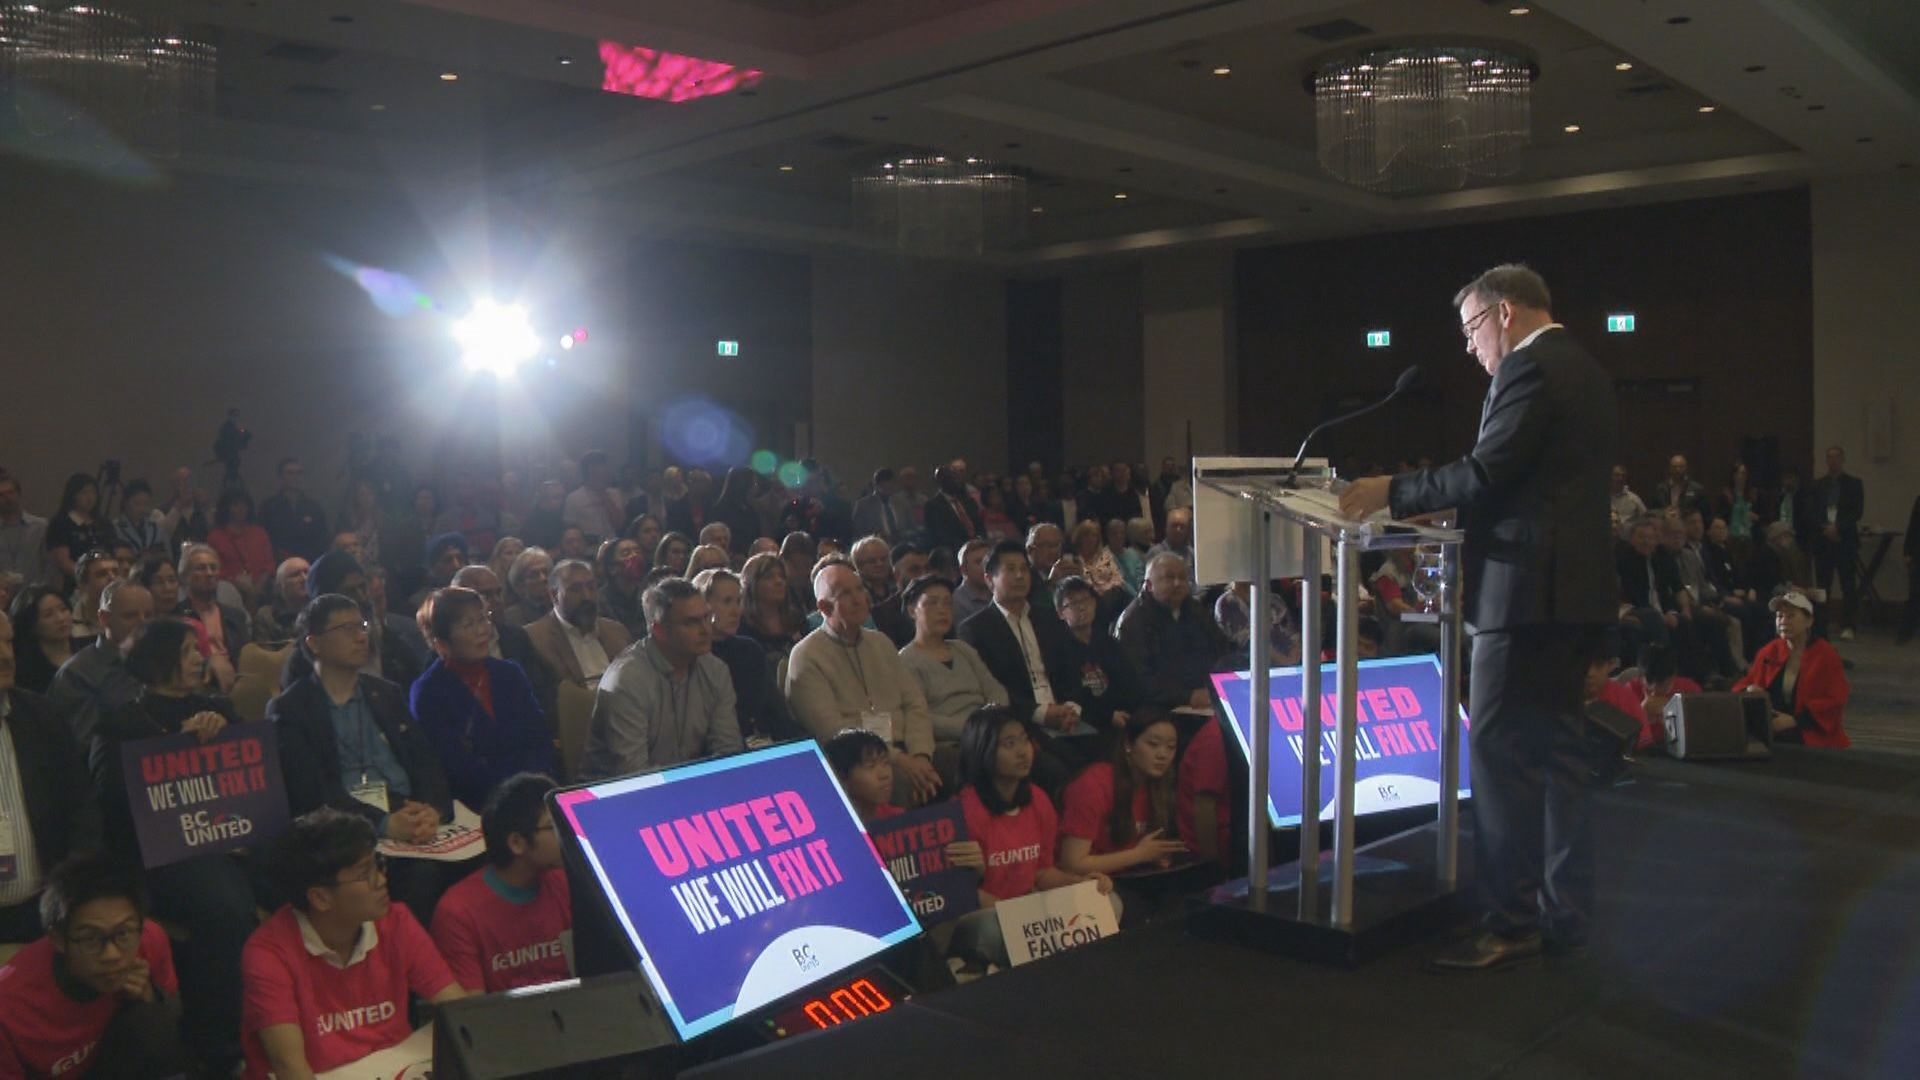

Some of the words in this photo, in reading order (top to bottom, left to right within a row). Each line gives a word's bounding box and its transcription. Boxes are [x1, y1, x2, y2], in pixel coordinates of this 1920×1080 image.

[1372, 723, 1416, 757] FIX
[1409, 720, 1438, 752] IT
[140, 738, 263, 784] UNITED
[147, 782, 177, 812] WE
[176, 775, 219, 806] WILL
[218, 769, 247, 797] FIX
[248, 765, 267, 793] IT
[180, 811, 210, 831] BC
[184, 819, 253, 847] UNITED
[639, 791, 816, 878] UNITED
[875, 818, 956, 856] NITED
[671, 875, 731, 935] WE
[712, 859, 786, 920] WILL
[768, 847, 822, 901] FIX
[806, 839, 845, 887] IT
[911, 896, 945, 916] ITED
[1022, 916, 1065, 938] KEVIN
[1027, 925, 1100, 958] FALCON
[792, 944, 809, 967] BC
